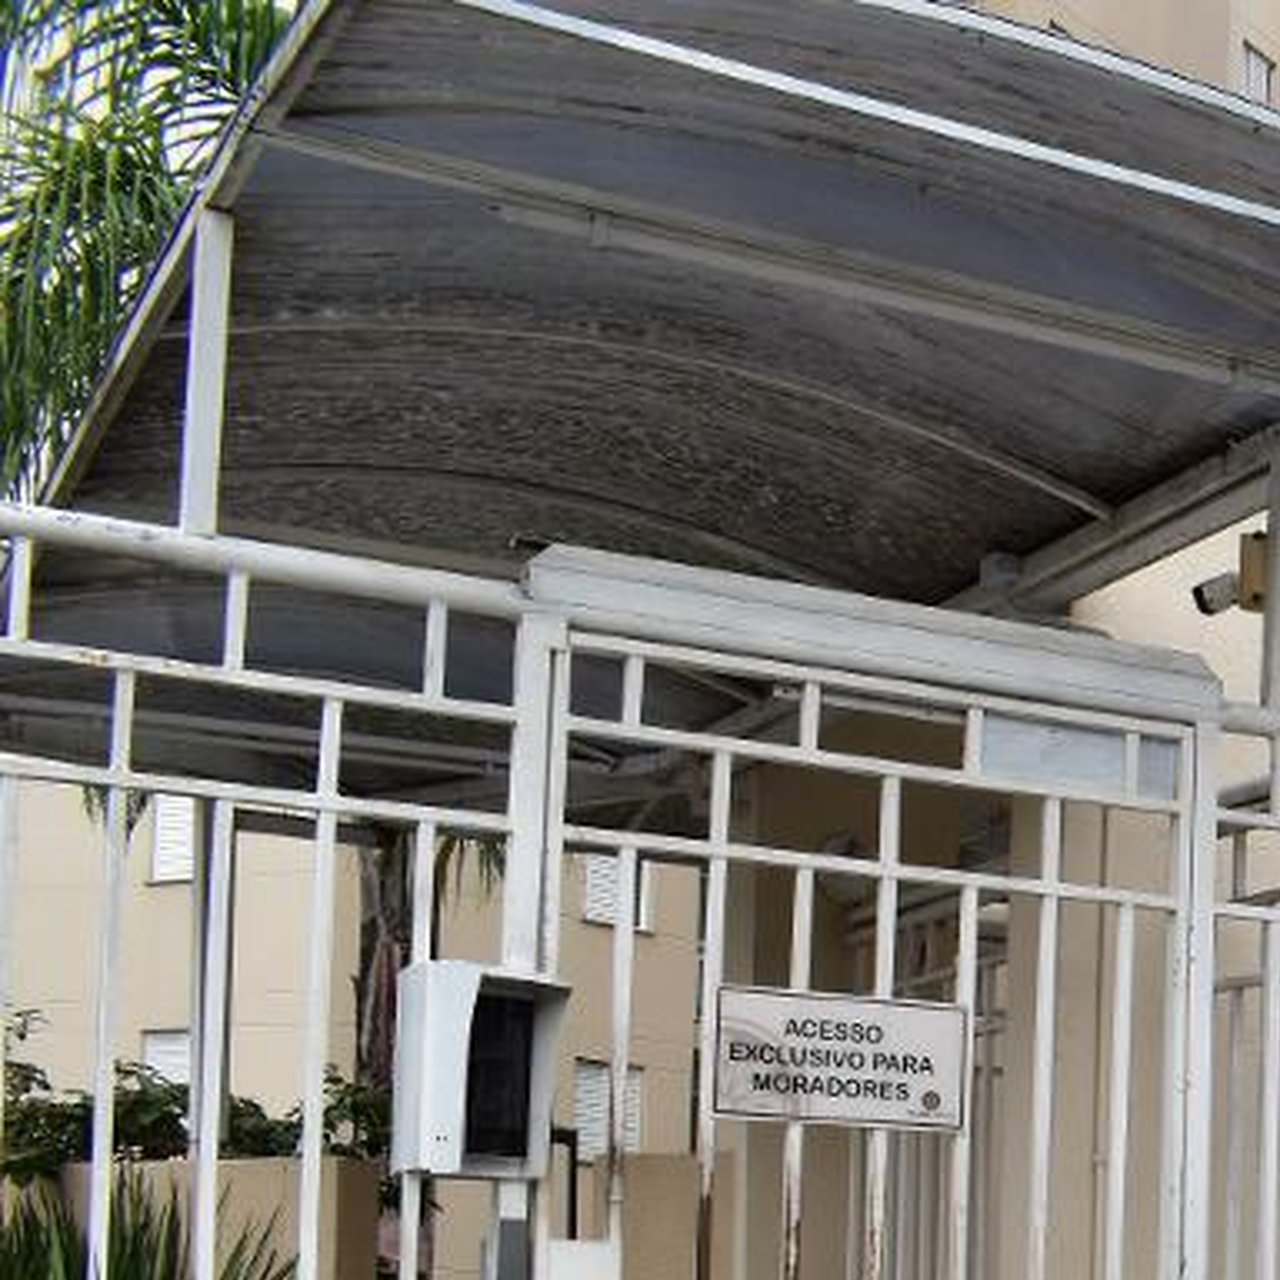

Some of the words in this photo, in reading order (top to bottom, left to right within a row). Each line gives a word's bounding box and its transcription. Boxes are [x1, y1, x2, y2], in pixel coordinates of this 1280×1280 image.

[783, 1018, 885, 1045] ACESSO
[728, 1041, 866, 1071] EXCLUSIVO
[872, 1051, 935, 1076] PARA
[751, 1072, 911, 1102] MORADORES
